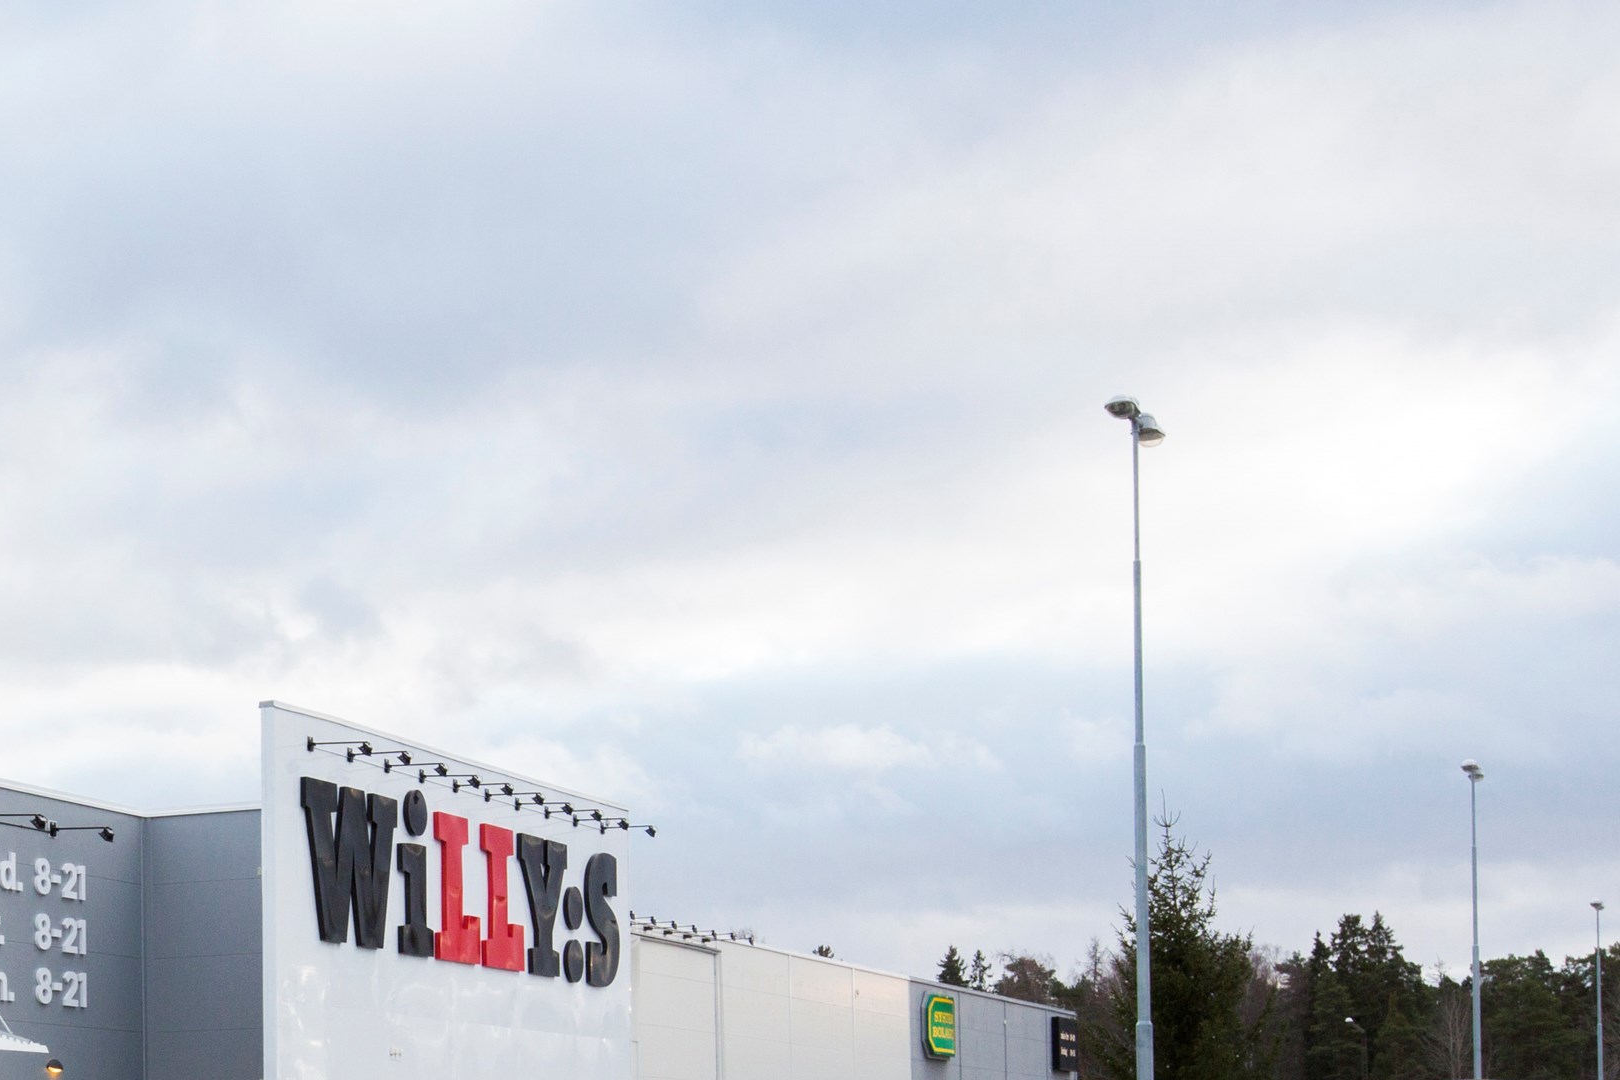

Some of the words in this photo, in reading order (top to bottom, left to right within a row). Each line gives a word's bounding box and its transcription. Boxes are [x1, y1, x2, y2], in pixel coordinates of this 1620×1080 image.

[34, 858, 87, 901] 8-21
[34, 912, 87, 955] 8-21
[35, 967, 88, 1008] 8-21
